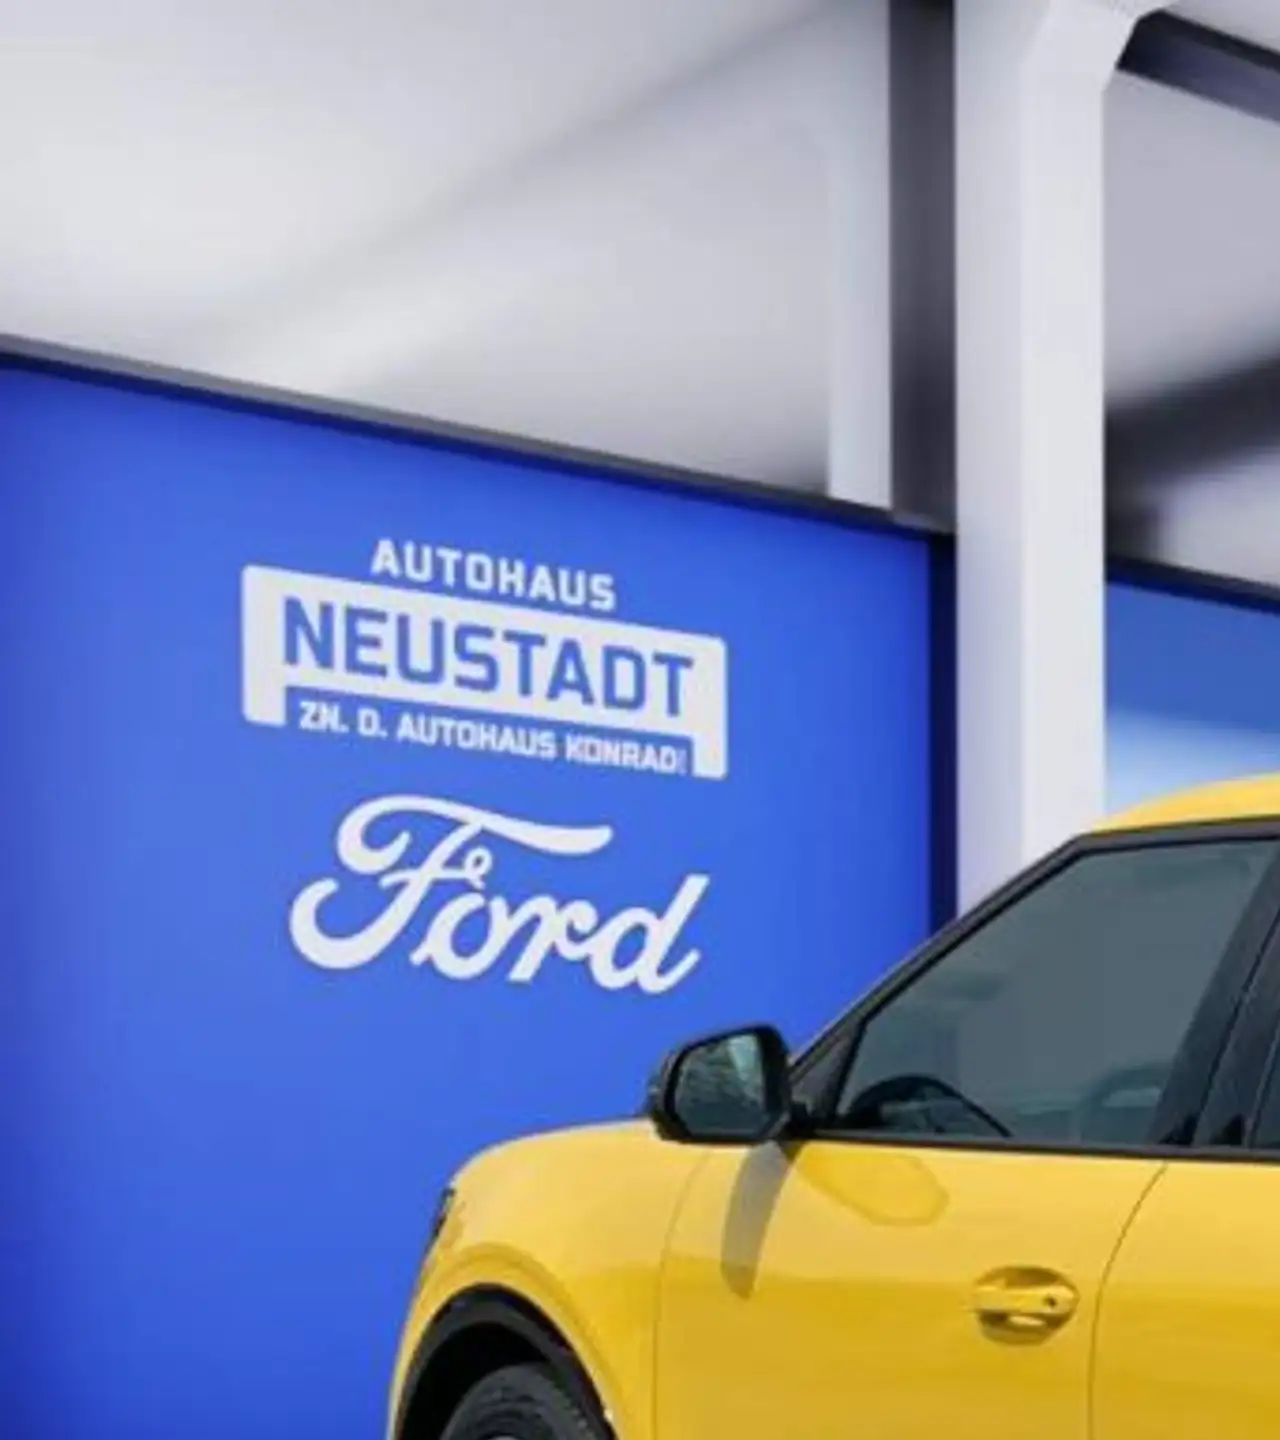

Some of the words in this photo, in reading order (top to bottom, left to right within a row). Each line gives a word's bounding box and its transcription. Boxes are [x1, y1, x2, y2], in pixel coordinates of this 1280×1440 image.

[371, 538, 616, 611] AUTOHAUS
[283, 595, 694, 718] NEUSTADT
[299, 700, 349, 733] ZN.
[358, 707, 388, 740] D.
[397, 711, 557, 761] AUTOHAUS
[565, 733, 678, 775] KONRAD
[289, 793, 710, 995] Ford
